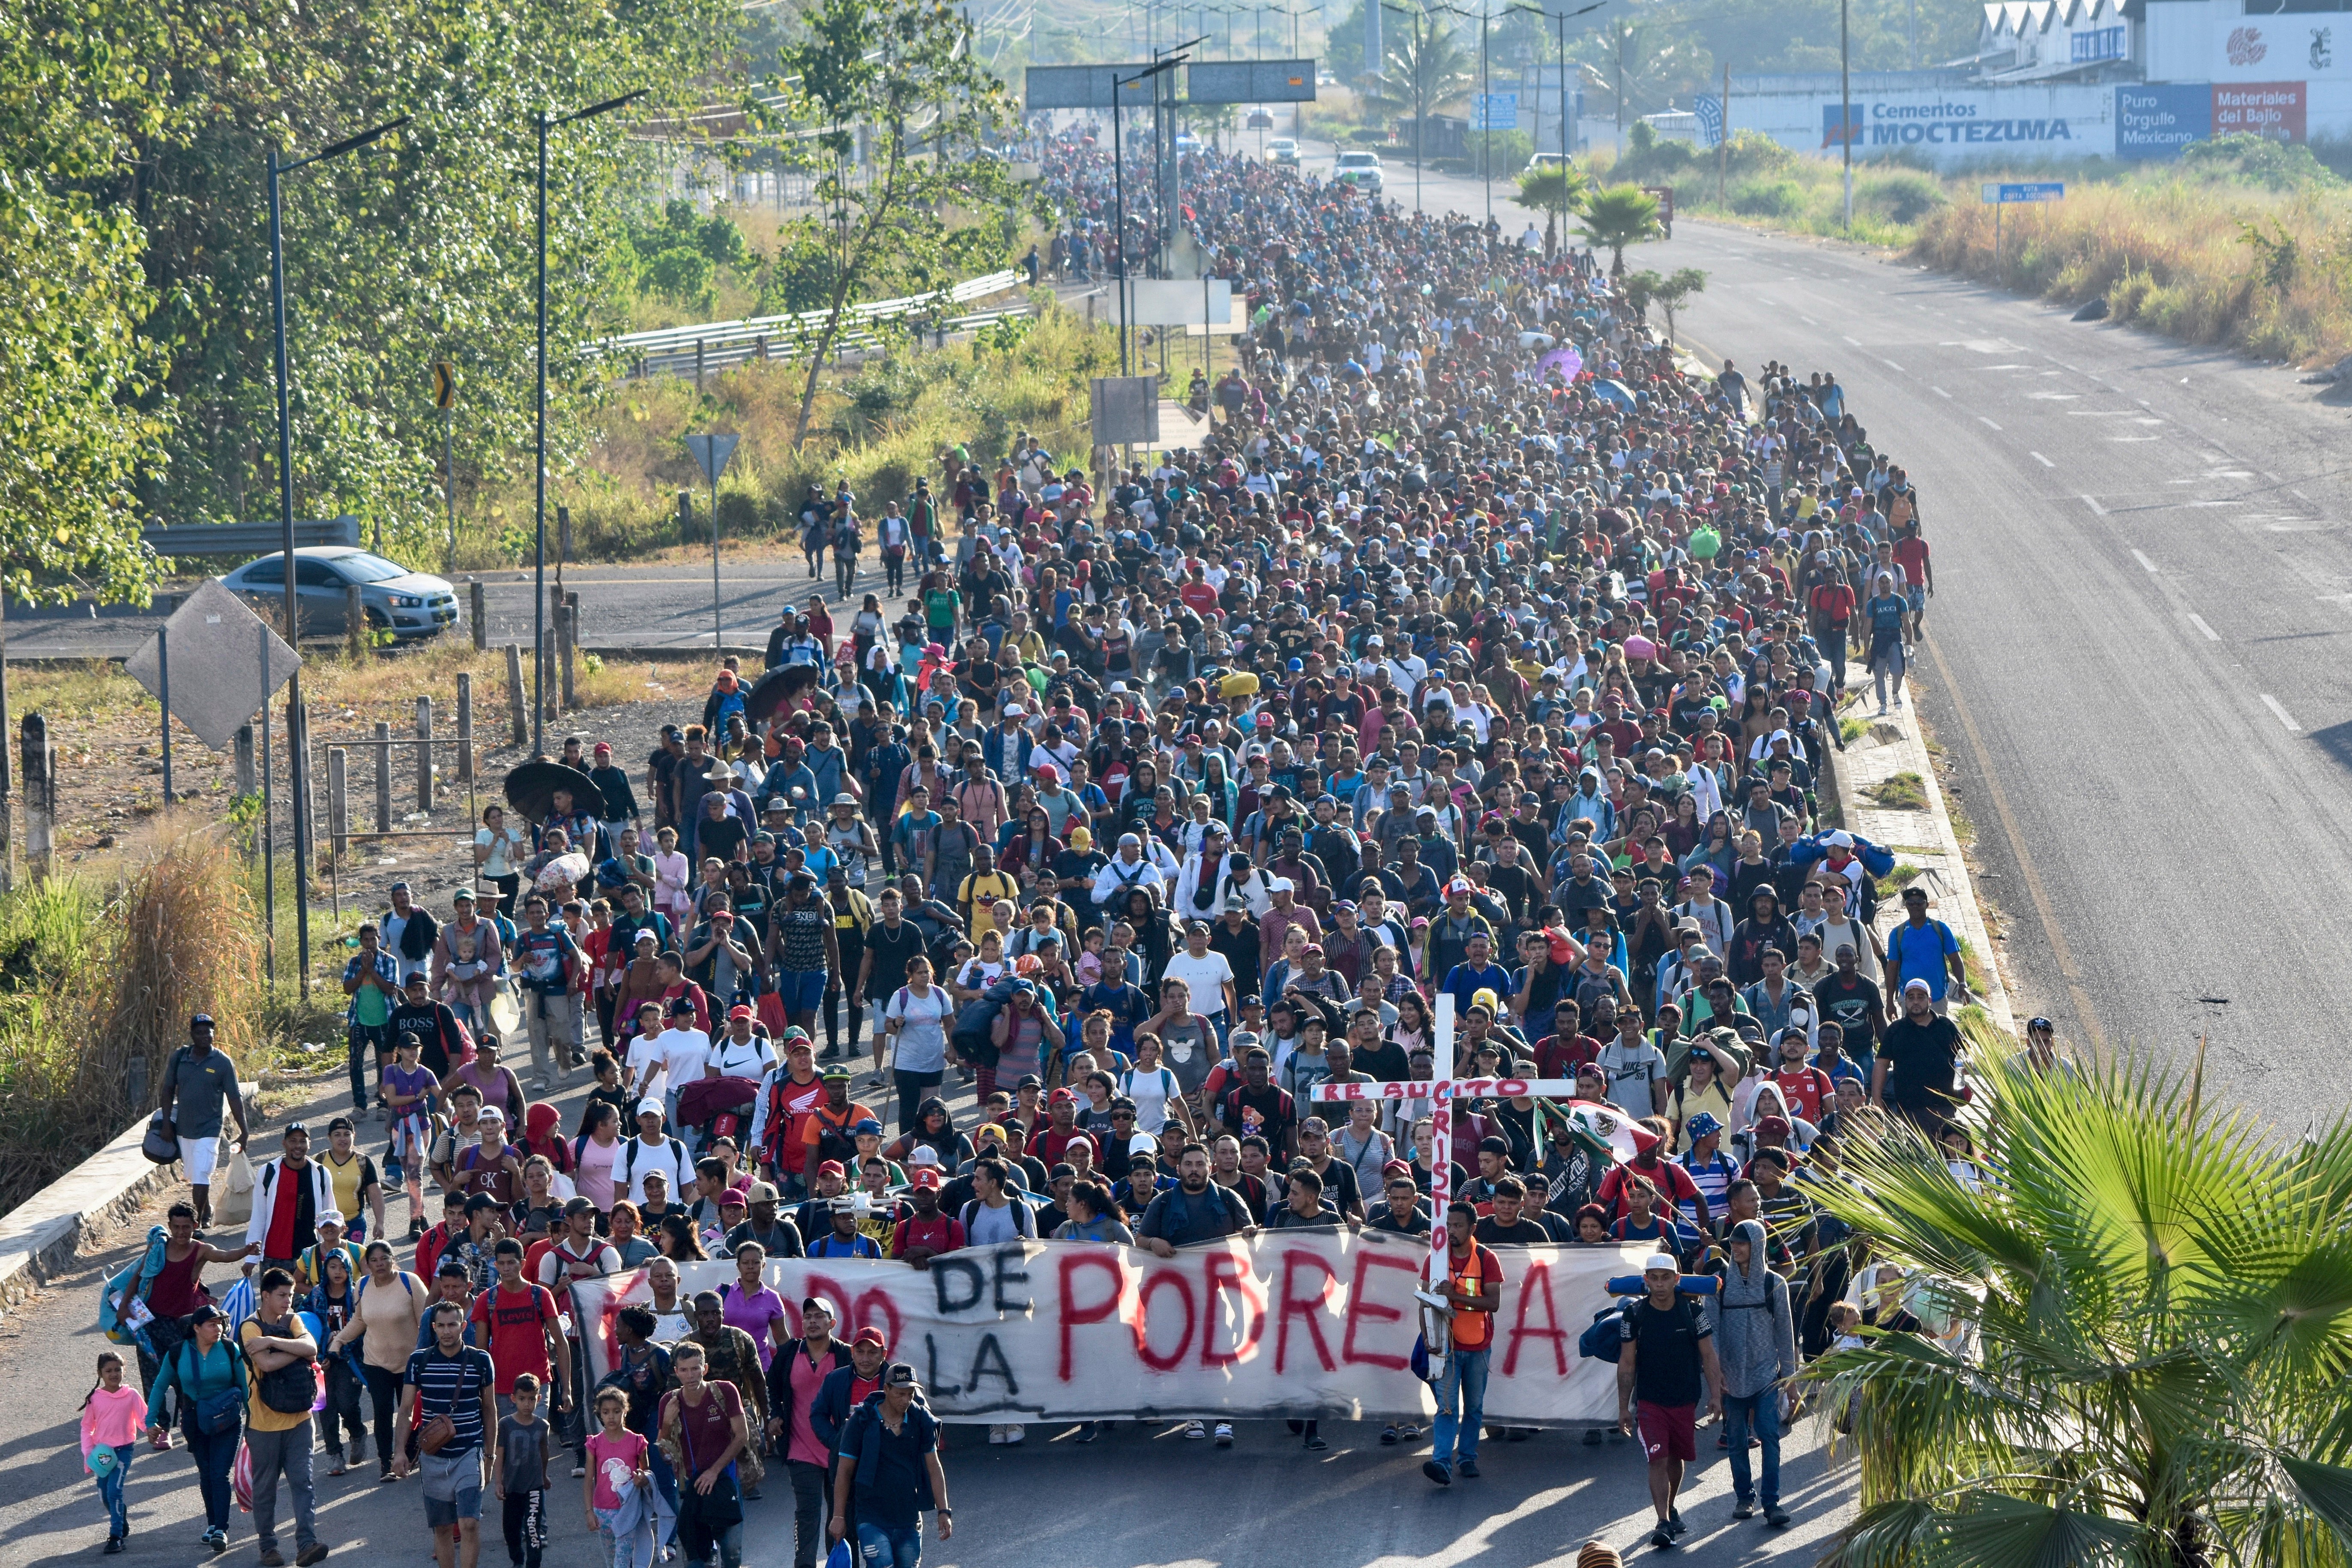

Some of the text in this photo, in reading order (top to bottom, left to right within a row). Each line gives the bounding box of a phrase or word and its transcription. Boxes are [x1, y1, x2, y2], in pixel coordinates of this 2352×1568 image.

[2122, 94, 2157, 108] Puro
[2218, 91, 2296, 106] Materiales
[1872, 102, 1976, 118] Cementos
[2218, 109, 2240, 123] del
[2123, 112, 2175, 130] Orgullo
[1872, 118, 2071, 145] MOCTEZUMA
[2123, 130, 2193, 144] Mexicano
[399, 1017, 434, 1029] BOSS
[1623, 1061, 1640, 1071] NIKE
[1325, 1083, 1365, 1101] RE
[1432, 1080, 1451, 1251] CRISTO
[930, 1245, 1033, 1314] DE
[1059, 1249, 1568, 1381] POBREA
[926, 1332, 1019, 1397] LA
[527, 1490, 540, 1549] SPIDER-MAN
